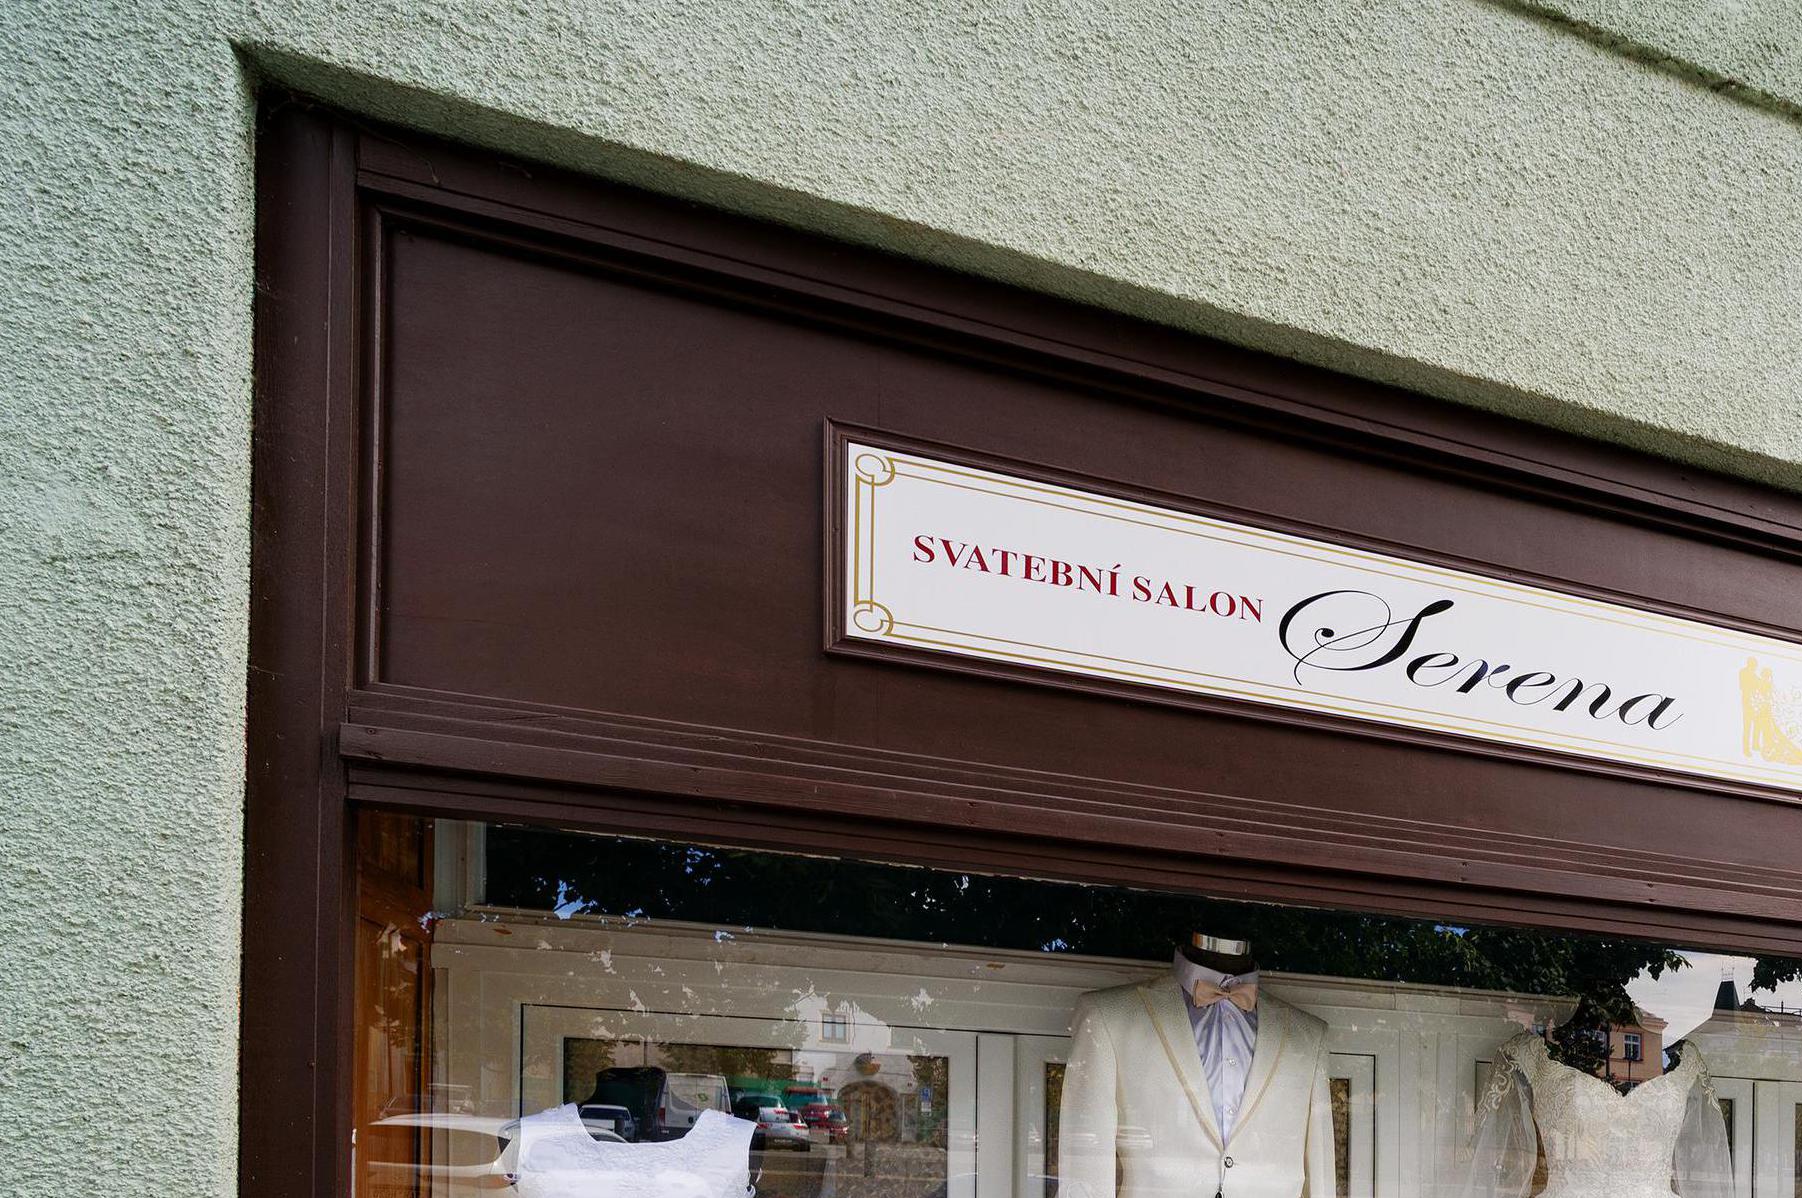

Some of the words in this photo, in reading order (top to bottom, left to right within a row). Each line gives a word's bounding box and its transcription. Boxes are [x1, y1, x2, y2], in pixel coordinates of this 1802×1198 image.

[912, 534, 1122, 597] SVATEBNÍ
[1132, 574, 1265, 623] SALON
[1278, 589, 1686, 732] Serena
